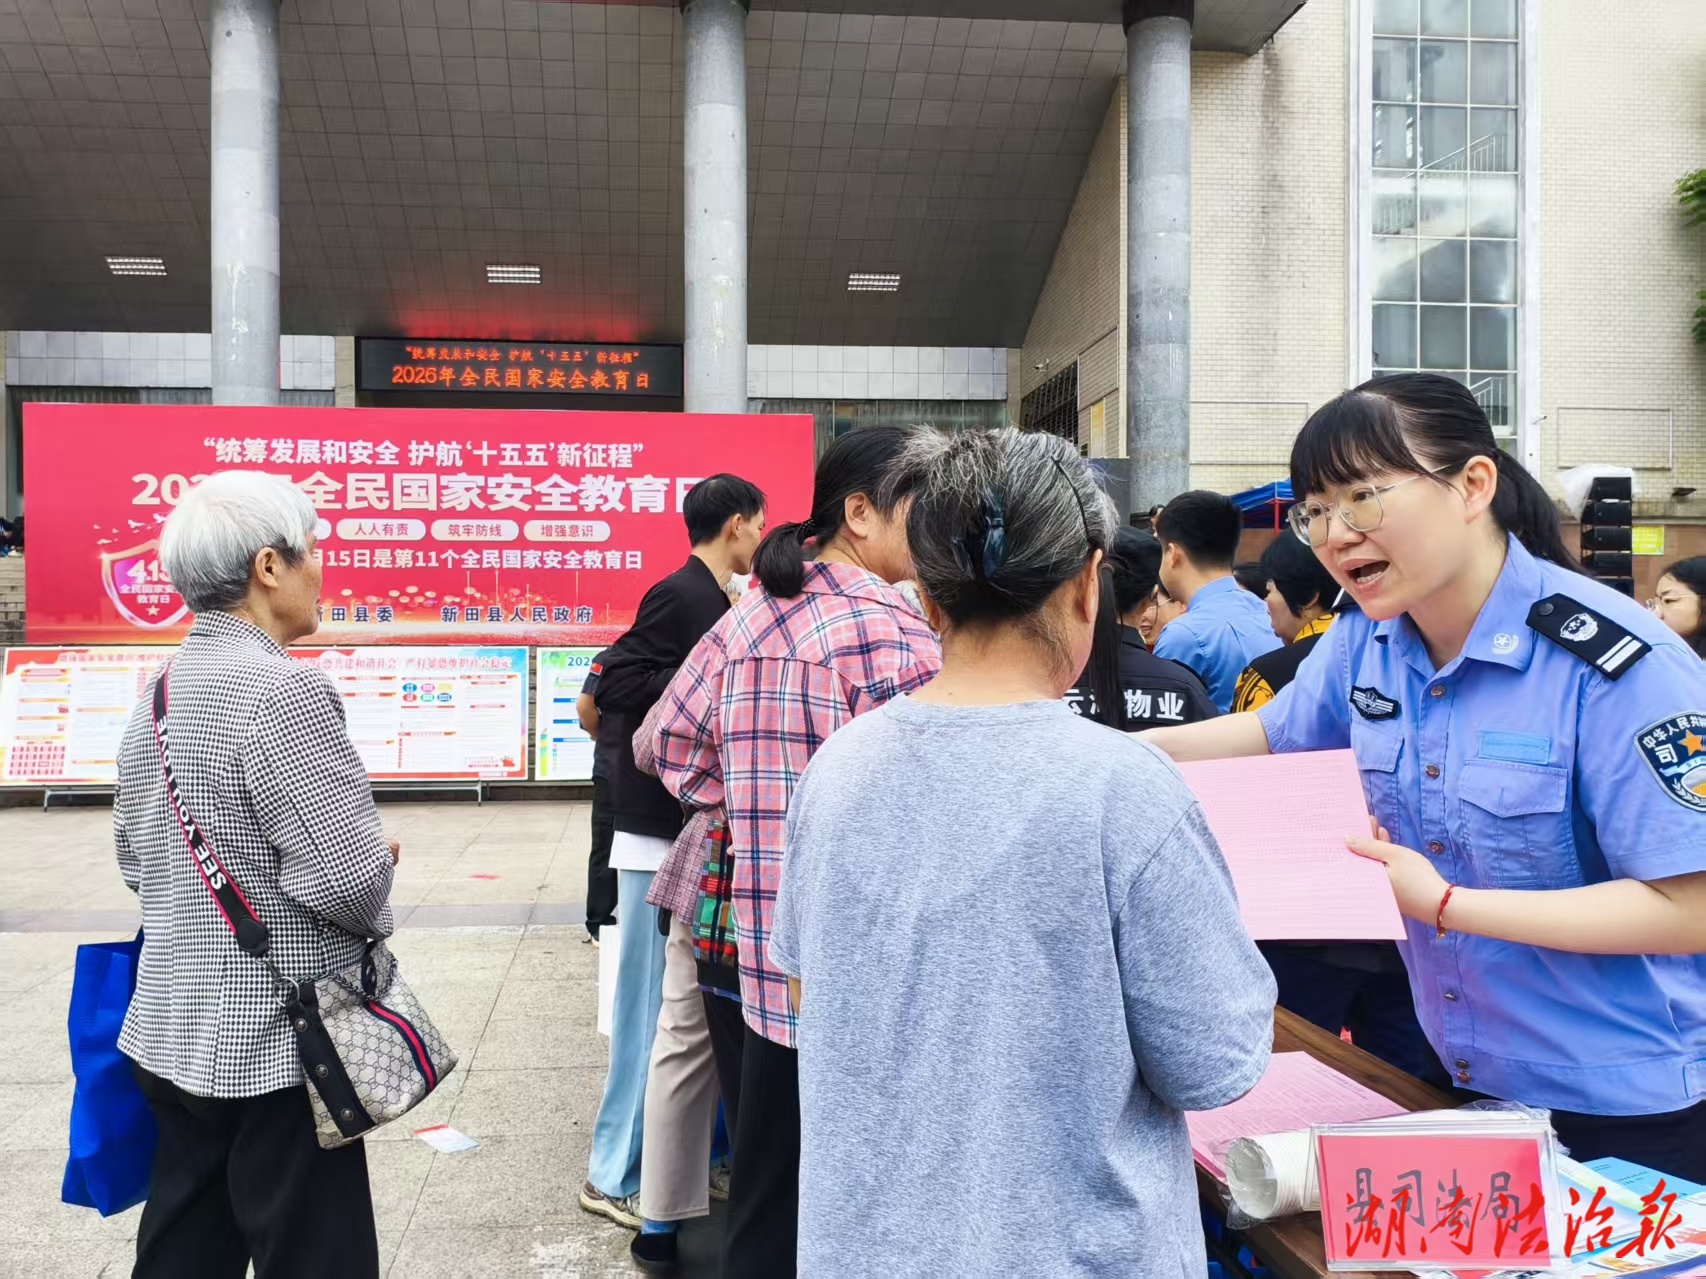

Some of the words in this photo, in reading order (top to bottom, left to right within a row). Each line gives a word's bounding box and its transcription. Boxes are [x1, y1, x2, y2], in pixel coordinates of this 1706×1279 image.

[391, 365, 649, 390] 2026年全民国家安全教育日
[203, 437, 400, 465] “统筹发展和安全
[131, 470, 705, 514] 20全民国家安全教育
[354, 522, 409, 536] 人人有责
[448, 524, 502, 537] 筑牢防线
[541, 524, 594, 538] 增强意识
[136, 594, 170, 604] 教育日
[319, 606, 394, 622] 田县委
[441, 606, 593, 624] 新田县人民政府
[1654, 743, 1678, 764] 司
[173, 788, 196, 841] YOU
[194, 842, 227, 890] SEE
